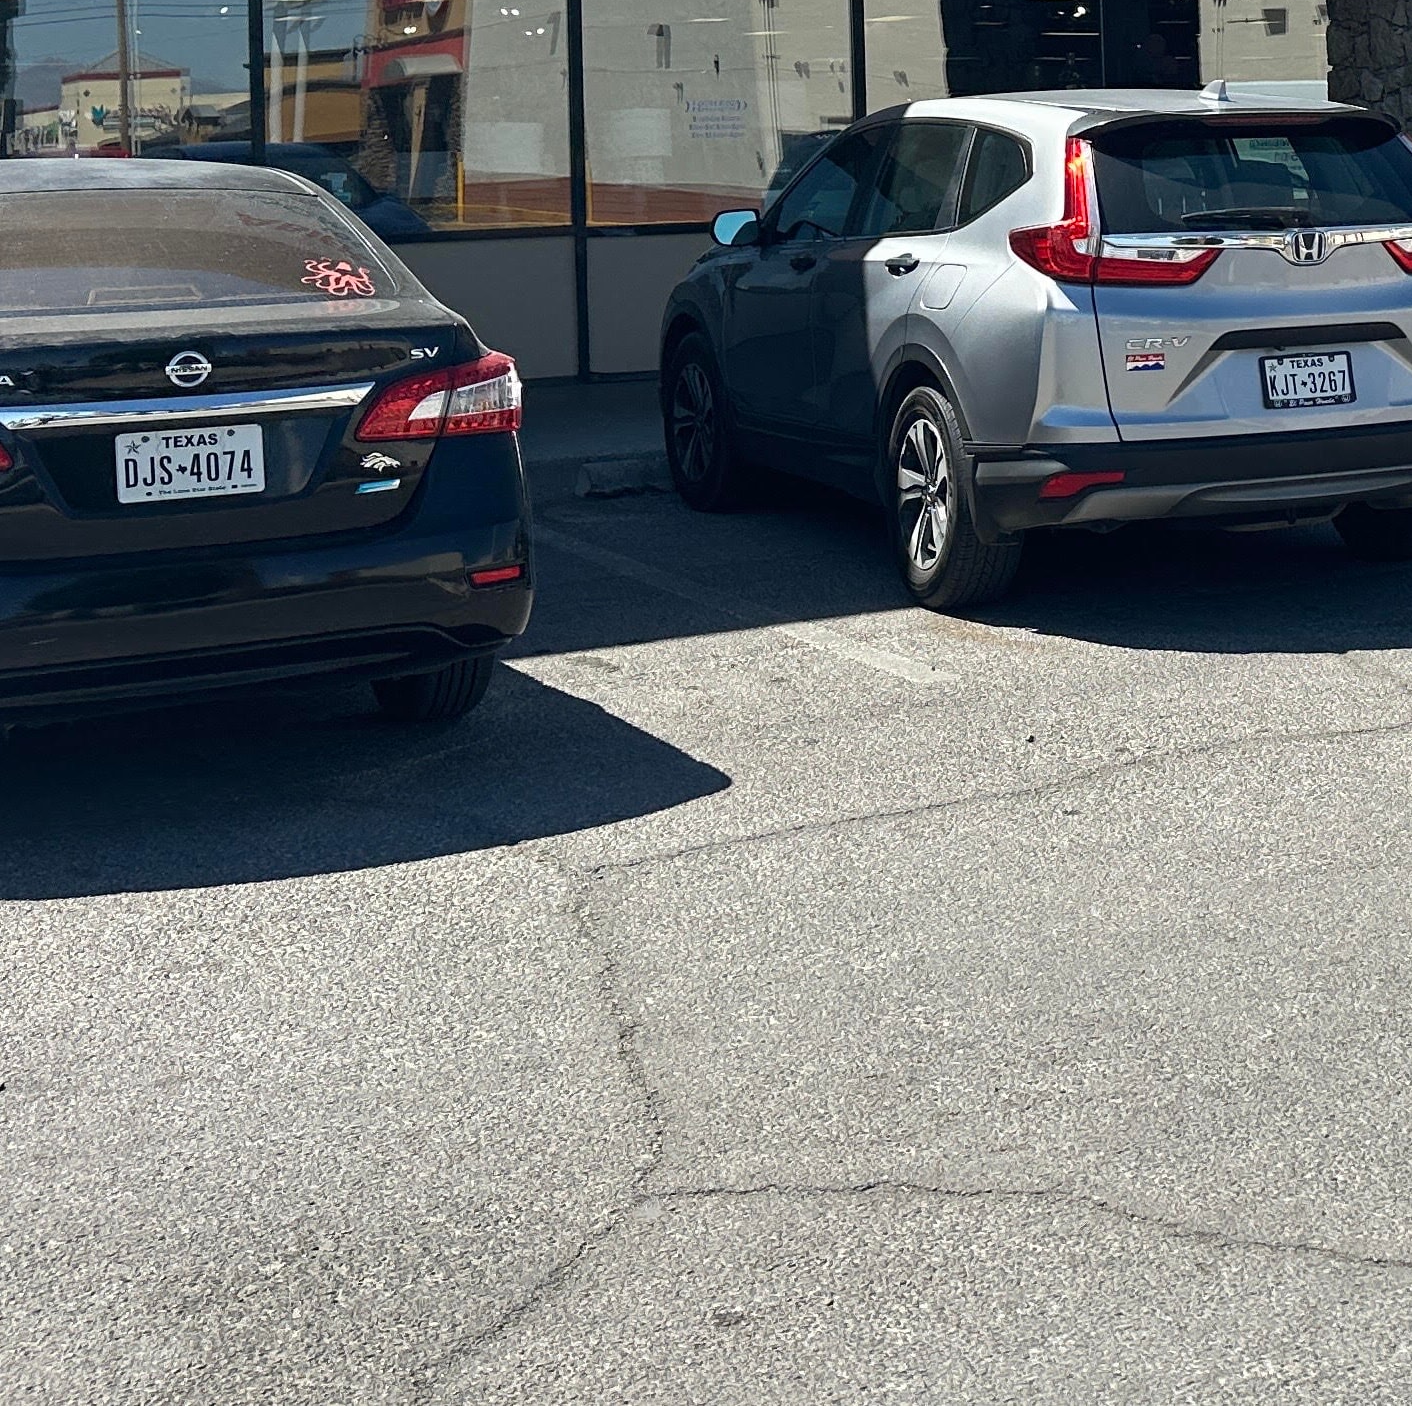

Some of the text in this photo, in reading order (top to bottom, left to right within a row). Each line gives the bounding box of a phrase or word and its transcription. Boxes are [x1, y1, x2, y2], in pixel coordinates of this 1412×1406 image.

[1126, 336, 1192, 350] CR-V
[410, 346, 439, 360] SV
[170, 364, 209, 374] NISSAN
[1289, 357, 1324, 369] TEXAS
[161, 433, 218, 449] TEXAS
